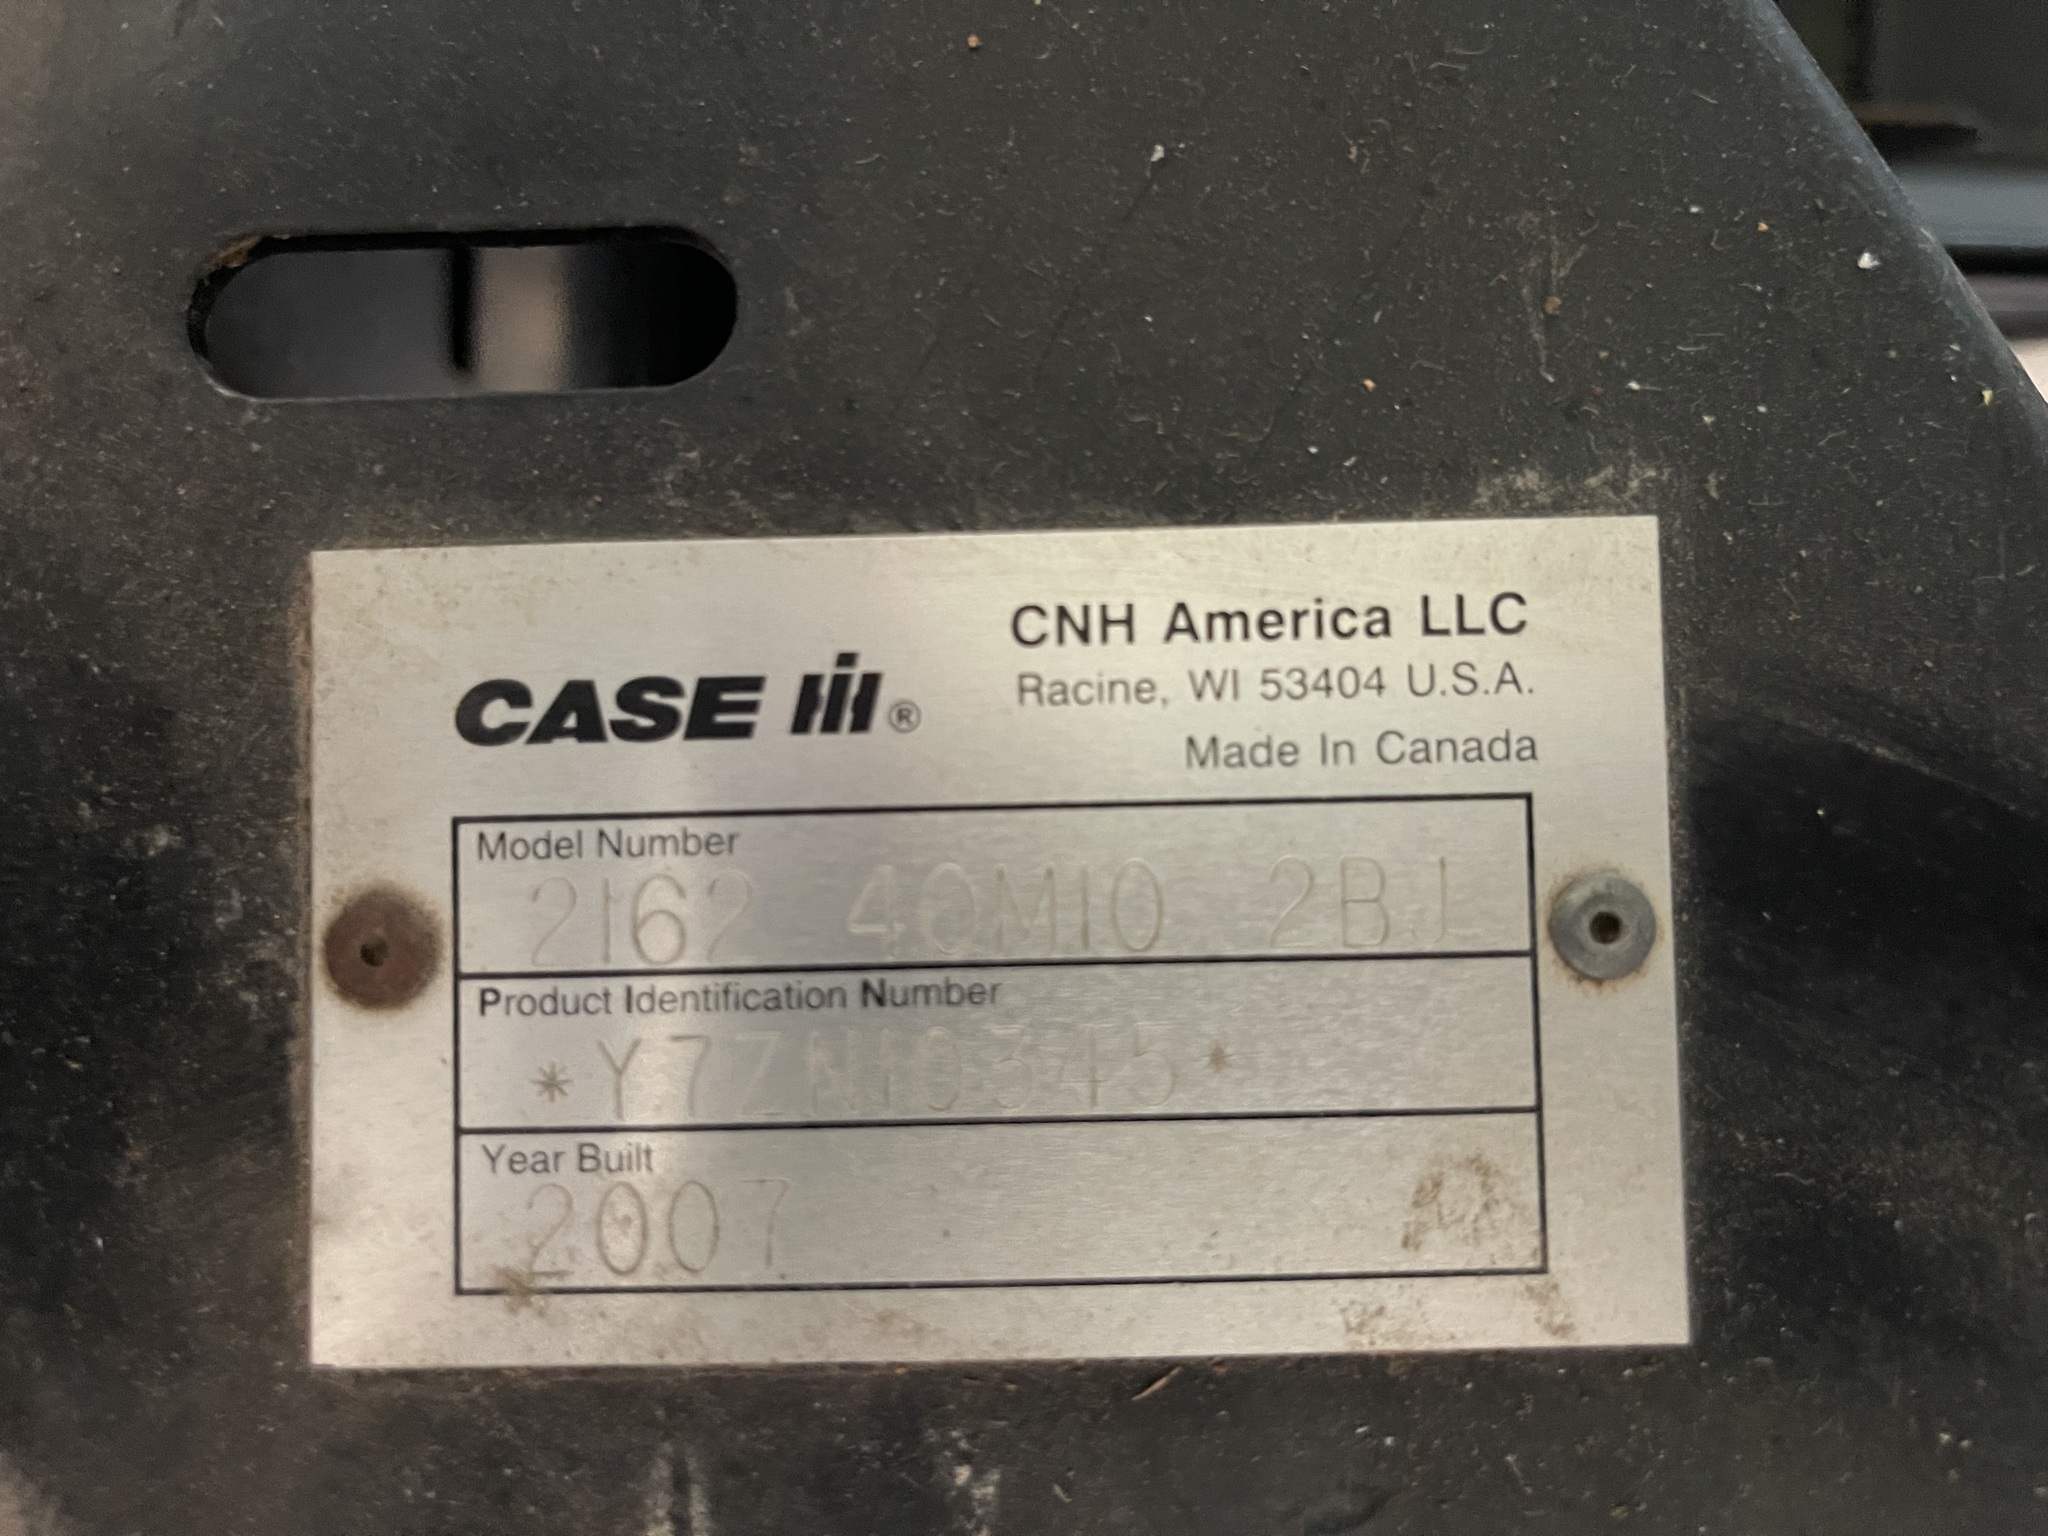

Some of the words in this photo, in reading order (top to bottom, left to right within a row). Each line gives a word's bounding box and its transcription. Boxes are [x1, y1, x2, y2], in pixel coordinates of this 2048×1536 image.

[1011, 601, 1136, 647] CNH
[1163, 597, 1393, 645] America
[1421, 592, 1528, 637] LLC
[1016, 670, 1168, 709] Racine,
[1187, 667, 1241, 701] WI
[1258, 665, 1387, 701] 53404
[1407, 660, 1535, 698] U.S.A.
[454, 676, 767, 747] CASE
[1185, 734, 1300, 769] Made
[1320, 732, 1357, 766] In
[1375, 728, 1539, 765] Canada
[476, 828, 584, 862] Model
[597, 826, 740, 860] Number
[529, 867, 757, 967] 2162
[478, 983, 613, 1018] Product
[624, 979, 848, 1016] Identification
[860, 976, 1003, 1010] Number
[481, 1143, 564, 1176] Year
[577, 1142, 655, 1176] Built
[526, 1179, 791, 1279] 2007
